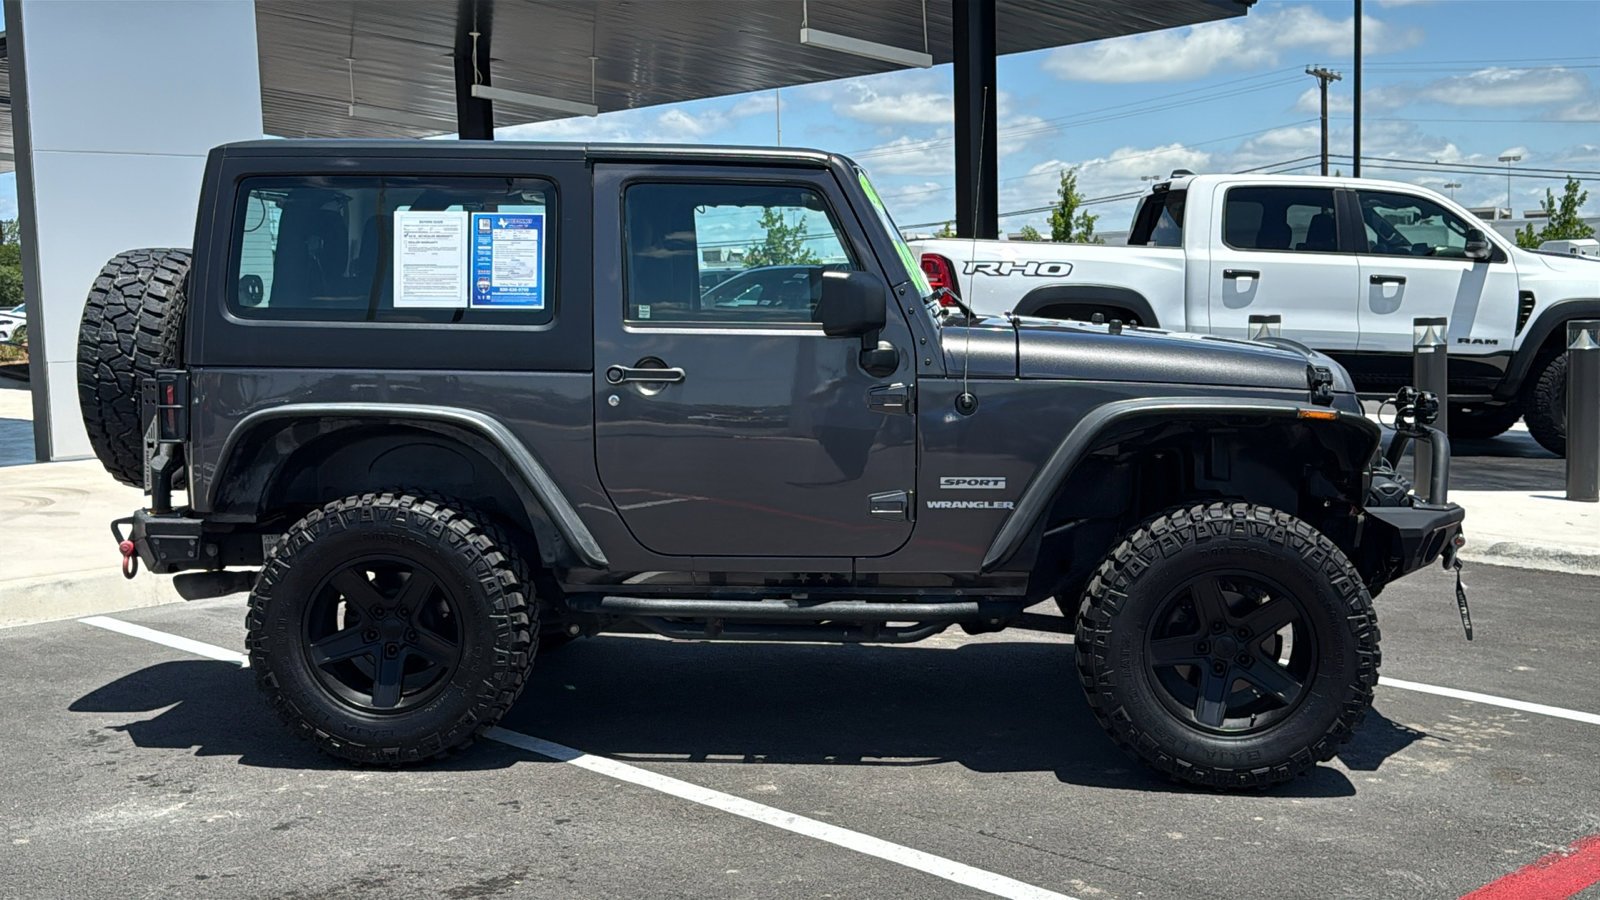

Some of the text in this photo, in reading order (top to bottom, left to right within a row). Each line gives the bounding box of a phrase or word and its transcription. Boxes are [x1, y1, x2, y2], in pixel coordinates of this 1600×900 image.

[962, 260, 1074, 278] RHO
[1457, 337, 1498, 345] RAM
[940, 478, 1006, 487] SPORT
[926, 501, 1014, 510] WRANGLER
